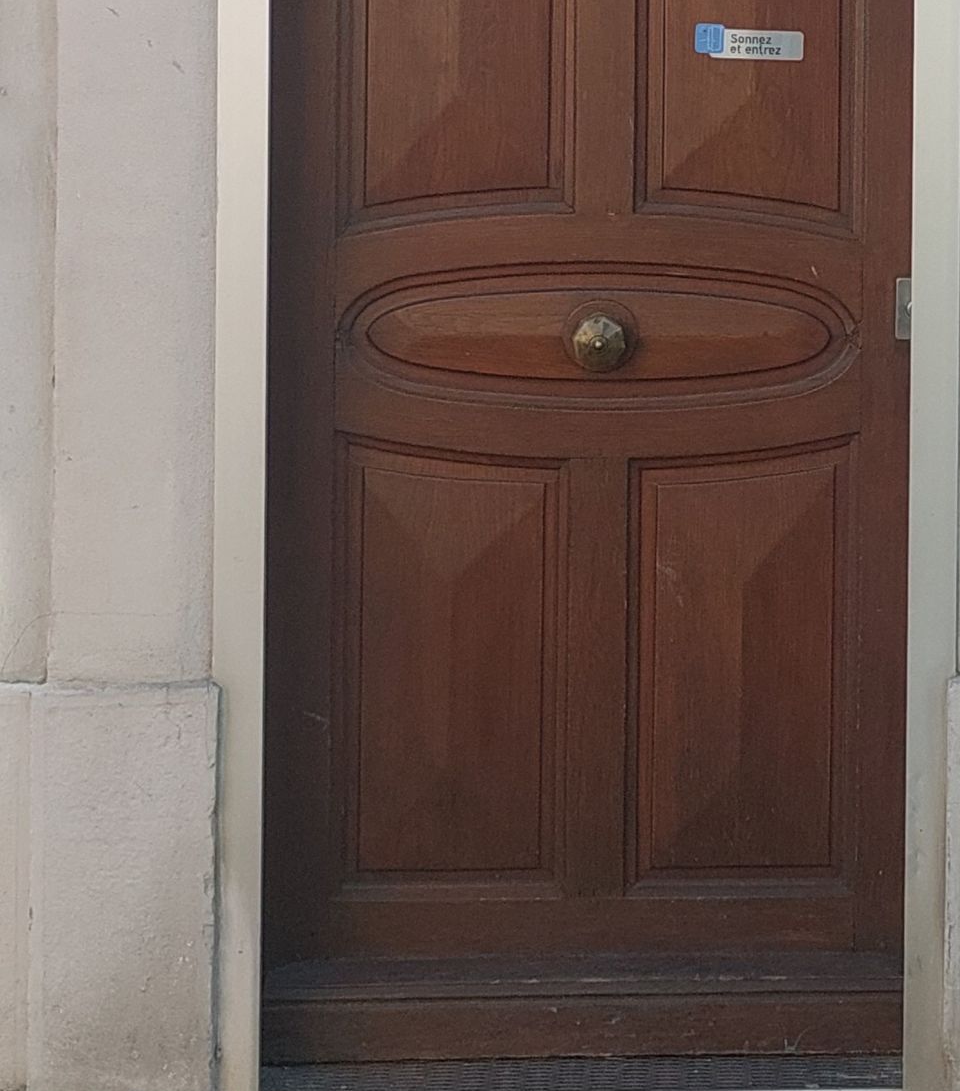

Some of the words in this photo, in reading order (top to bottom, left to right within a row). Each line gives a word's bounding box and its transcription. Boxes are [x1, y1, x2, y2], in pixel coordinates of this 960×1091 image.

[730, 33, 772, 45] Sonnez
[730, 45, 741, 54] et
[745, 45, 782, 56] entrez
